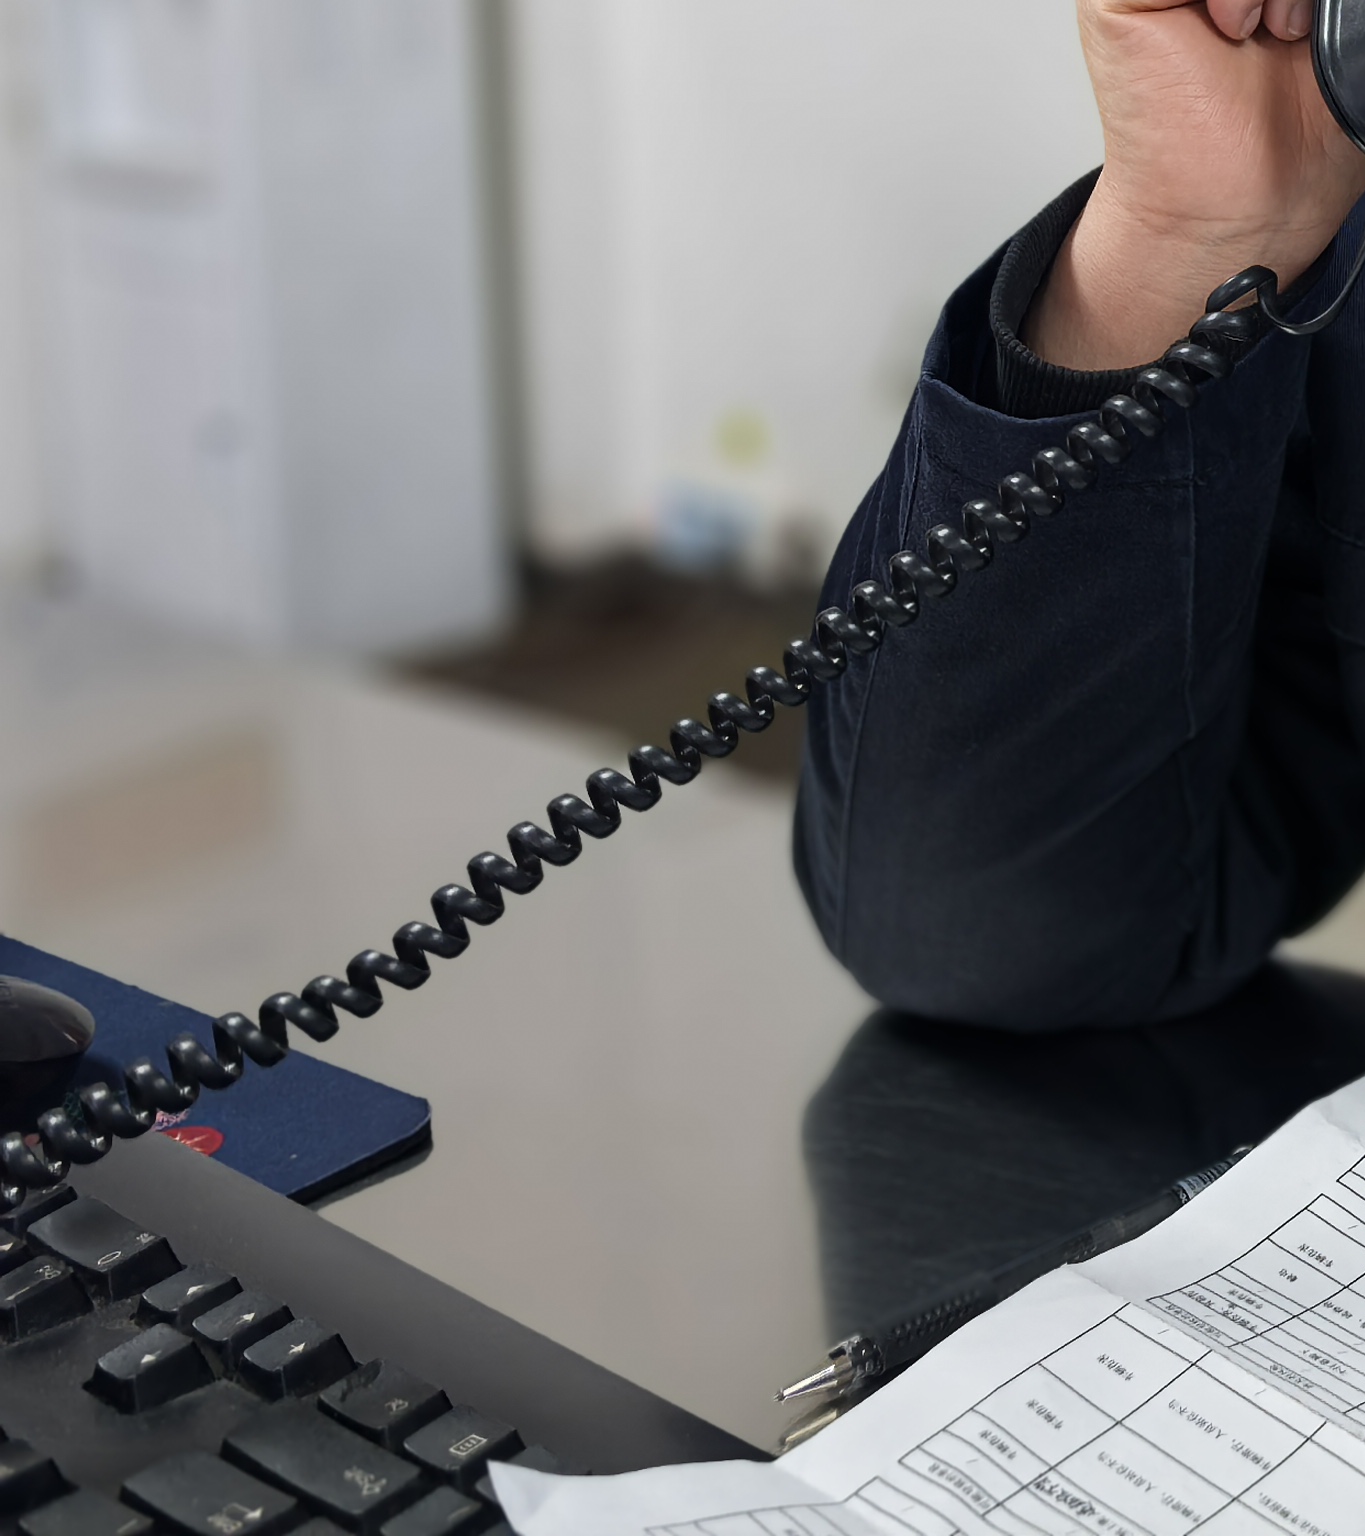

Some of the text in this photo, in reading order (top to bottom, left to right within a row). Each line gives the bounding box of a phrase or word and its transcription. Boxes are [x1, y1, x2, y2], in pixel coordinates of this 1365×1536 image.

[1296, 1243, 1333, 1269] 车辆伤害
[1097, 1354, 1133, 1381] 车辆伤害
[1026, 1399, 1063, 1430] 车辆伤害
[979, 1430, 1016, 1460] 车辆伤害
